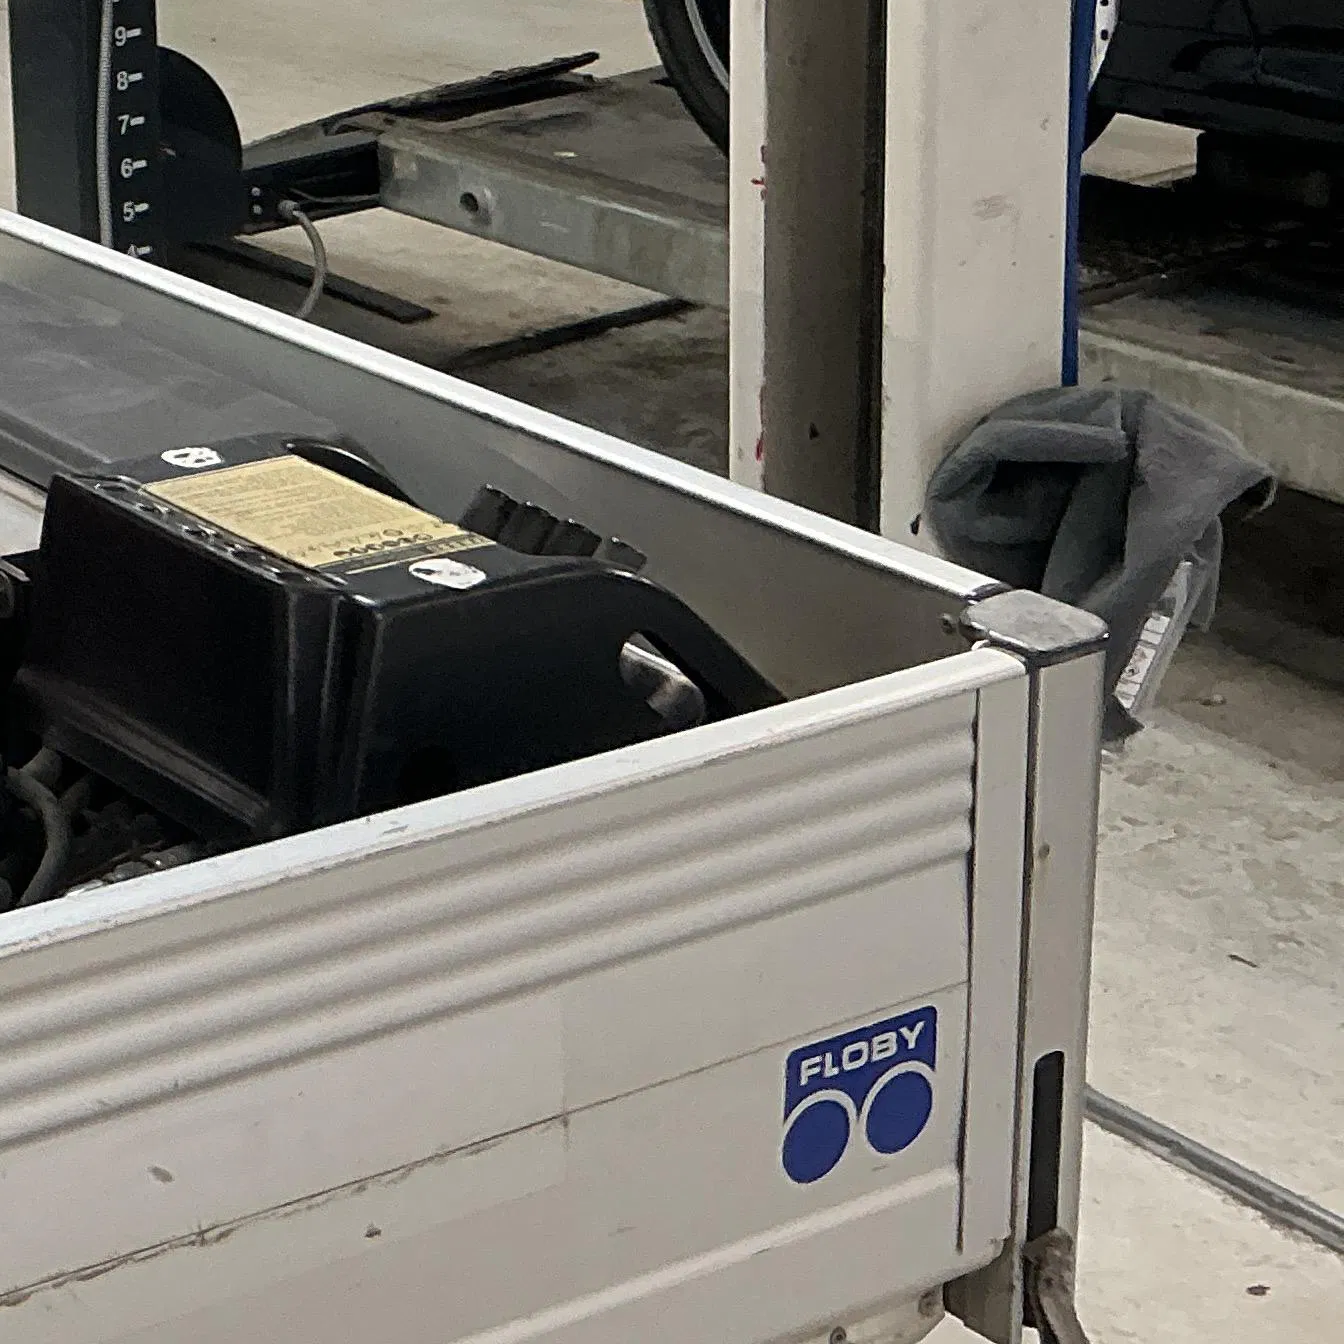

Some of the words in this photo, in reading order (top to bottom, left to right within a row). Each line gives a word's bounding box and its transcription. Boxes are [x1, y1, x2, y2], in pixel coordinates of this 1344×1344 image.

[115, 26, 126, 46] 9
[116, 71, 128, 90] 8
[118, 115, 130, 135] 7
[121, 159, 133, 178] 6
[123, 202, 135, 222] 5
[800, 1021, 926, 1086] FLOBY
